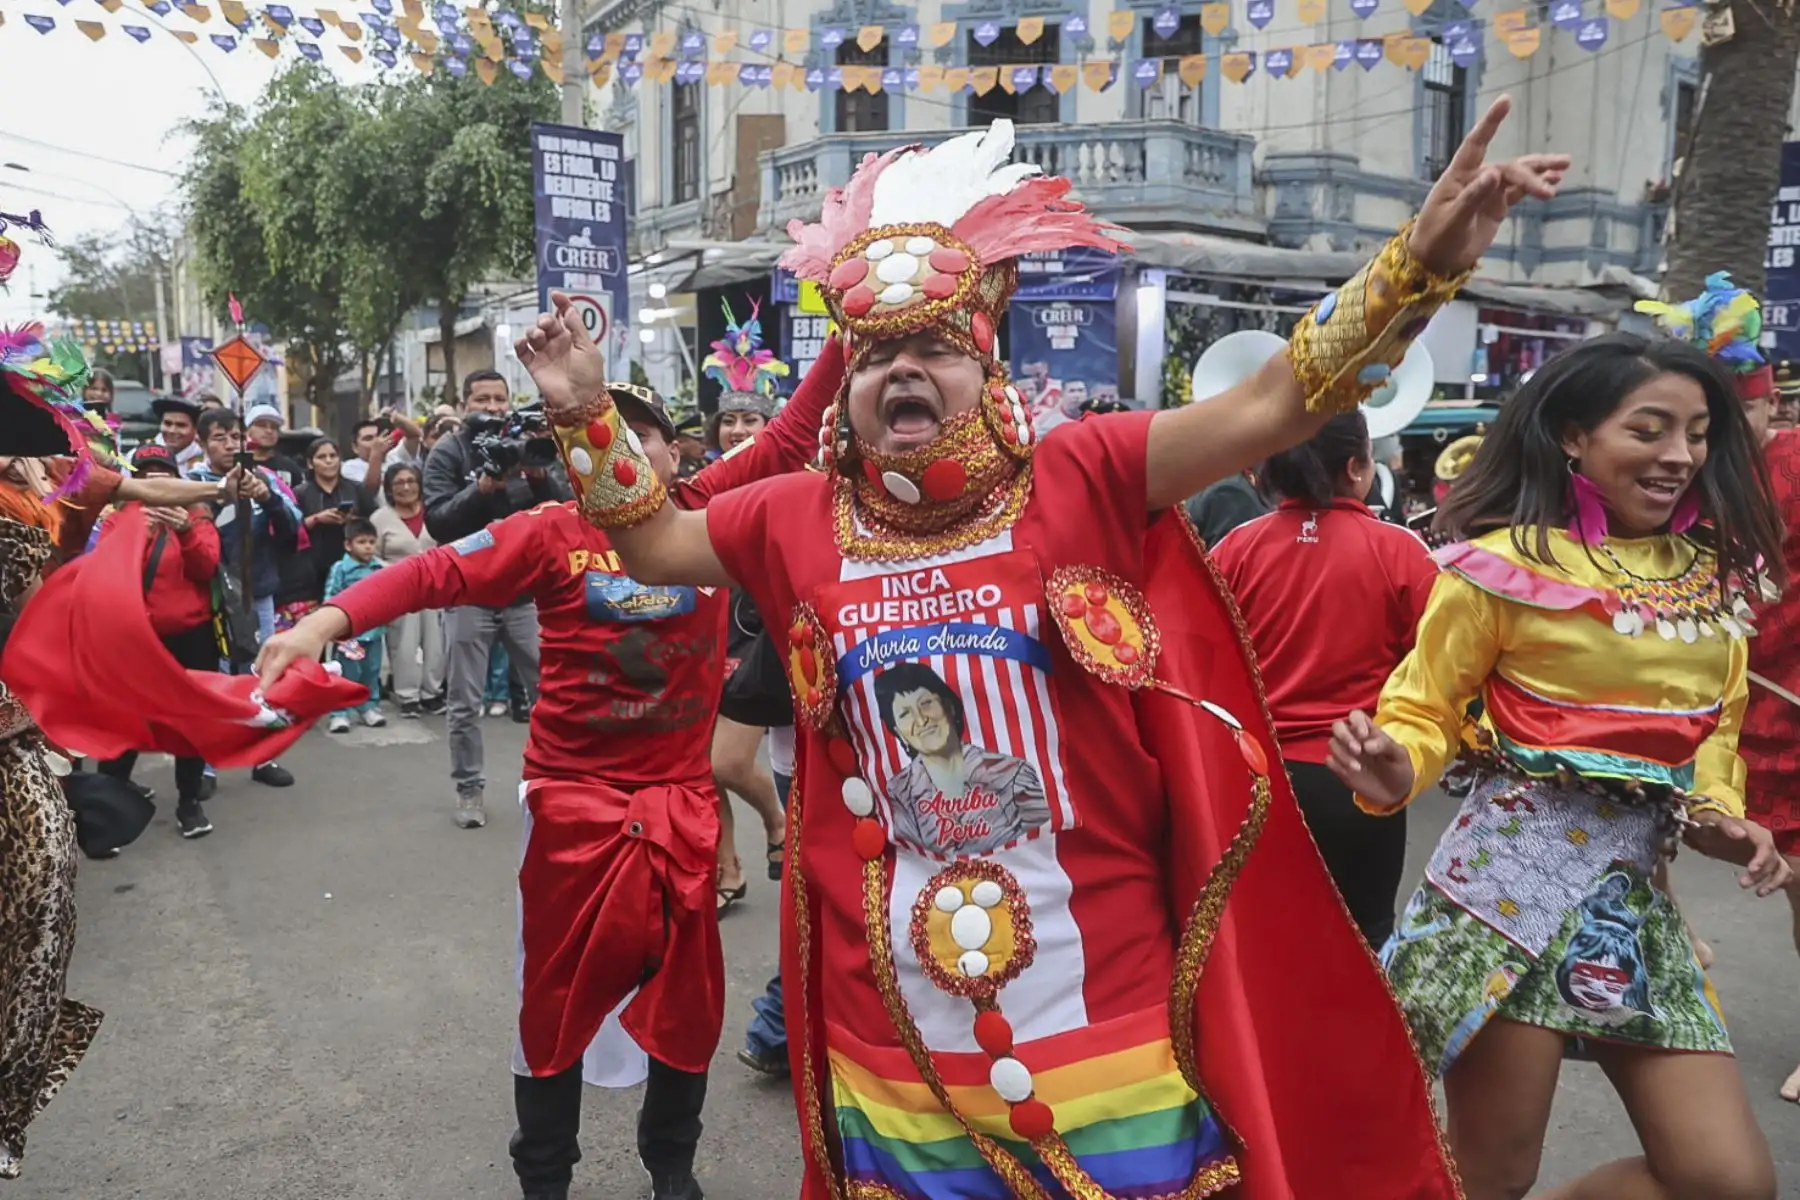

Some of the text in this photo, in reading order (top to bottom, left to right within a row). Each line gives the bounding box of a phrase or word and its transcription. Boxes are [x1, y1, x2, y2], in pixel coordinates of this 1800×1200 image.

[555, 246, 610, 270] CREER
[582, 308, 596, 331] 0
[881, 568, 951, 598] INCA
[837, 583, 1002, 627] GUERRERO
[926, 625, 1008, 652] Aranda
[916, 784, 999, 817] Arriba
